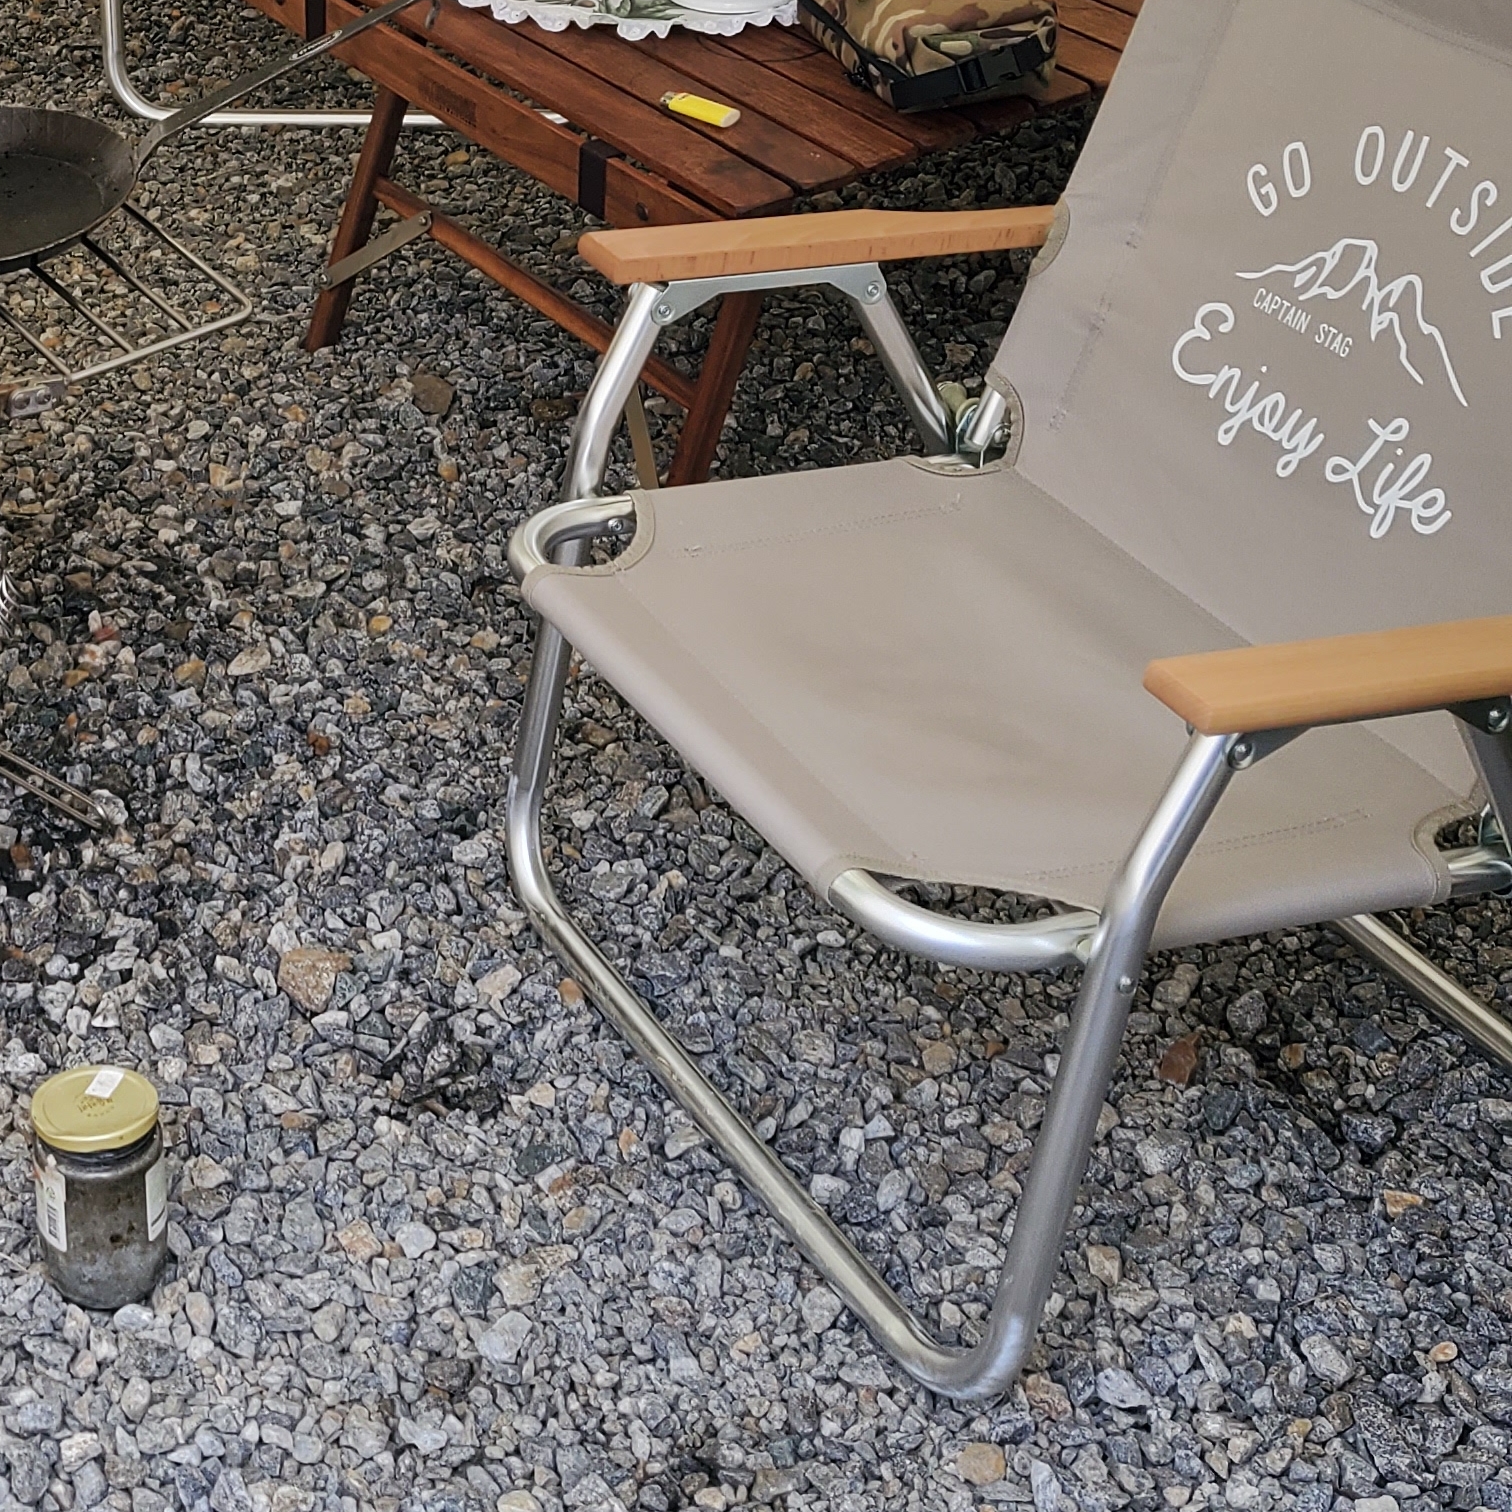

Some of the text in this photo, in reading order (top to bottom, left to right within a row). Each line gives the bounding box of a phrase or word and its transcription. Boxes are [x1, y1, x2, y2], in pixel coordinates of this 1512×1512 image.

[1246, 141, 1312, 217] GO
[1252, 287, 1354, 358] CAPTAIN STAG
[1172, 302, 1452, 539] Enjoy Life
